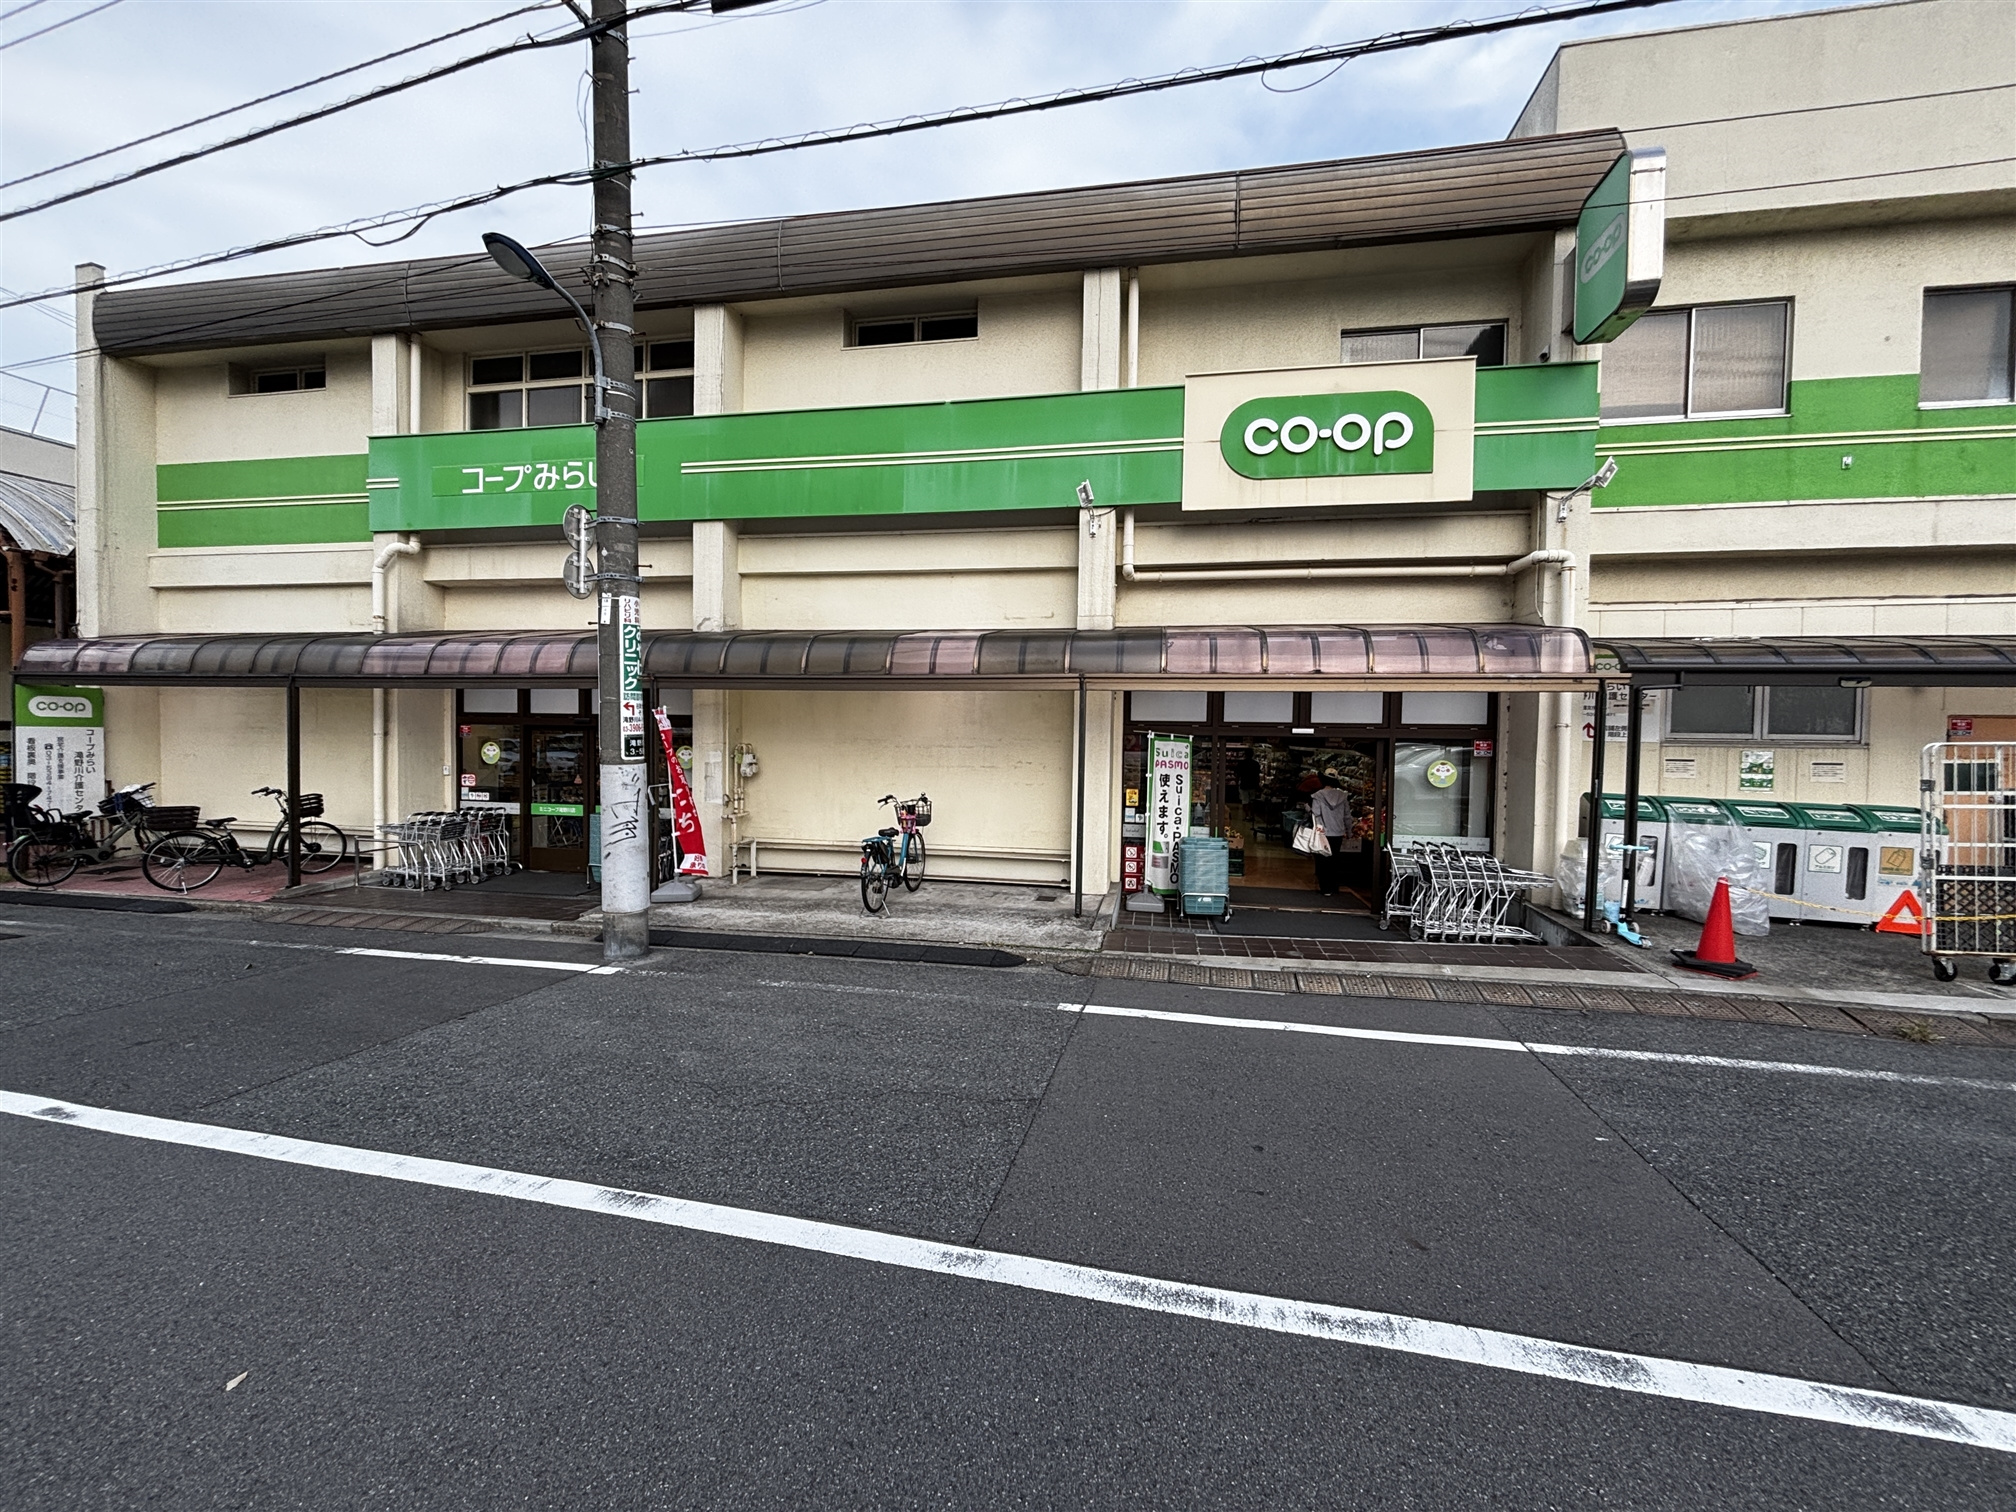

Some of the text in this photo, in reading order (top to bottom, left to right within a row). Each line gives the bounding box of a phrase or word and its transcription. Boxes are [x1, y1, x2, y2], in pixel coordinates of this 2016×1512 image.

[624, 625, 638, 690] クリニック
[1155, 760, 1189, 770] PASMO
[1156, 747, 1189, 759] Suica
[1156, 773, 1170, 839] 使えます。
